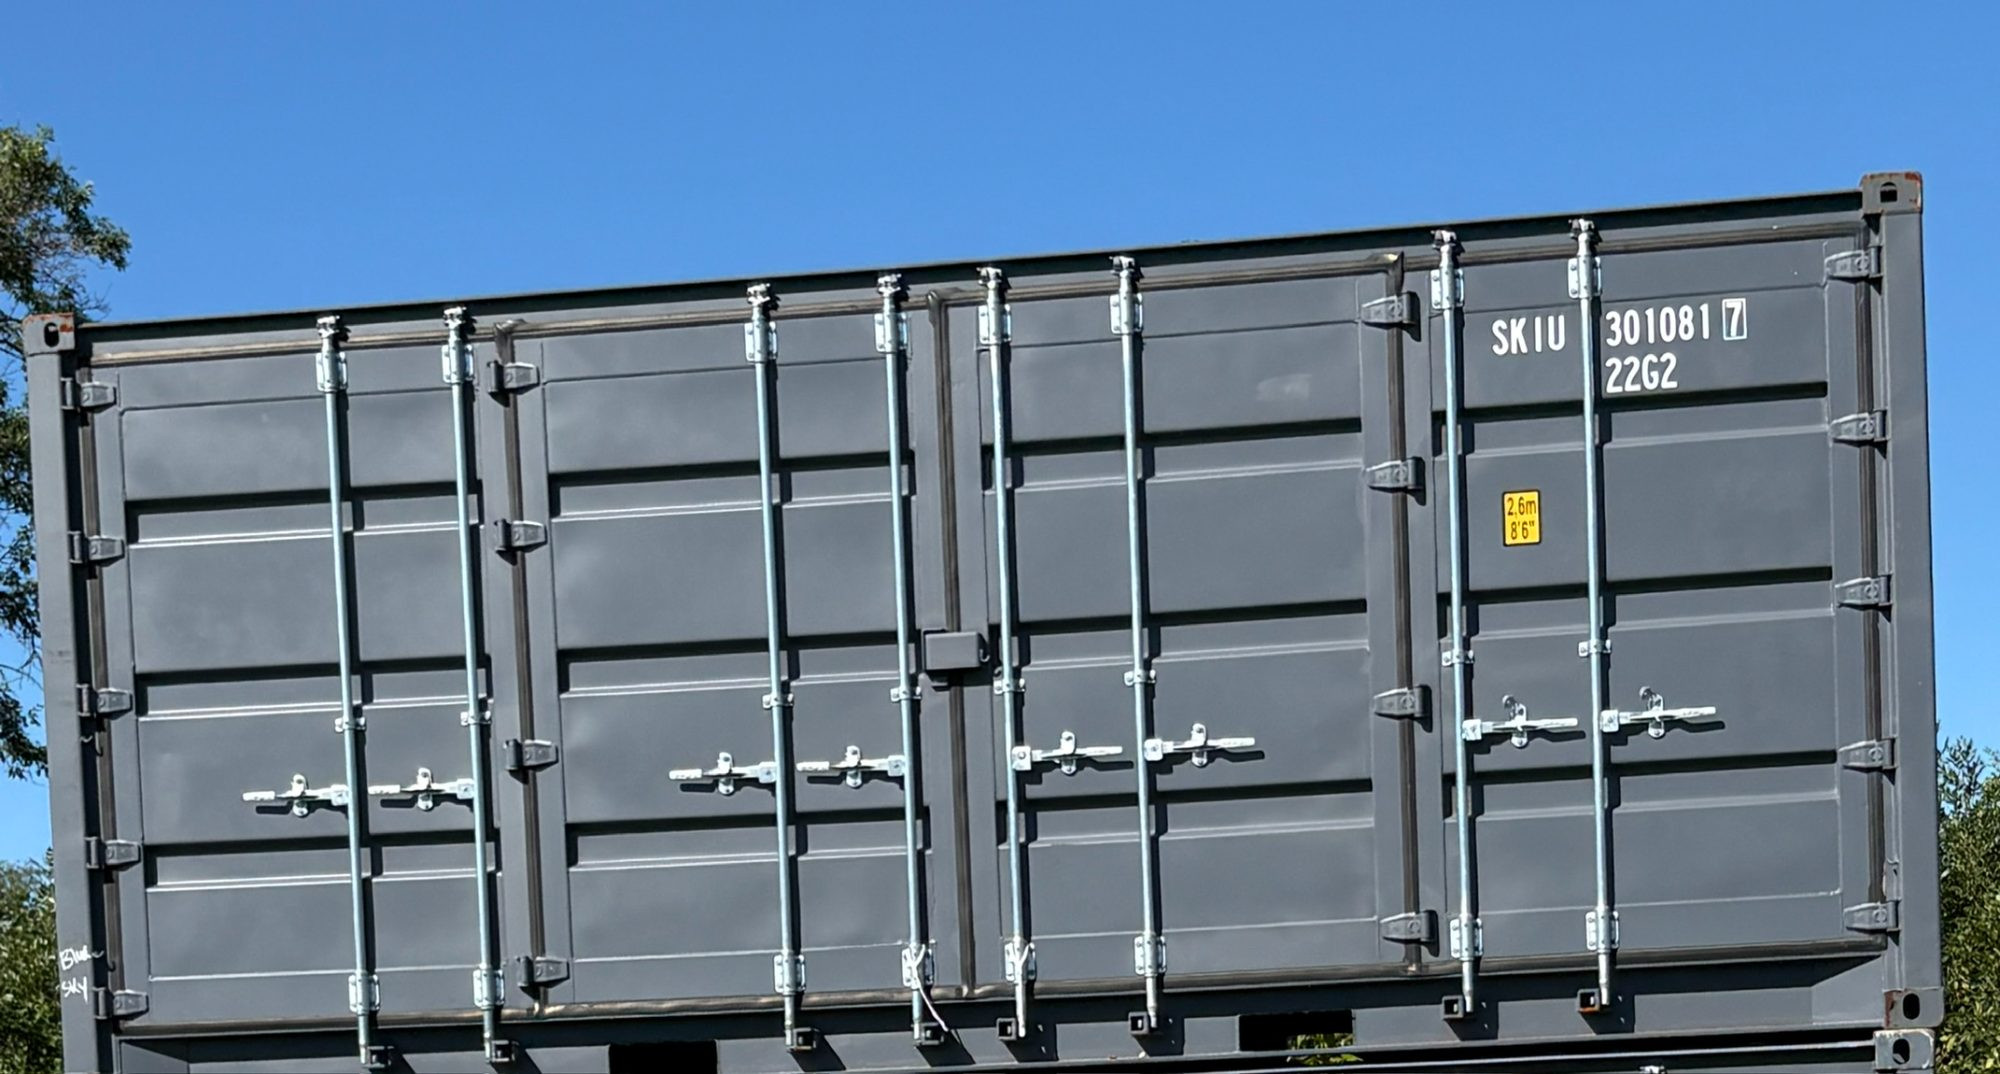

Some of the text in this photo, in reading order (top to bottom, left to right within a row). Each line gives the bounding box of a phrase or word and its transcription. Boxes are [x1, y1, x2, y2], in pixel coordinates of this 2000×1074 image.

[1492, 299, 1744, 355] SKIU 301081 7
[1605, 352, 1678, 393] 22G2
